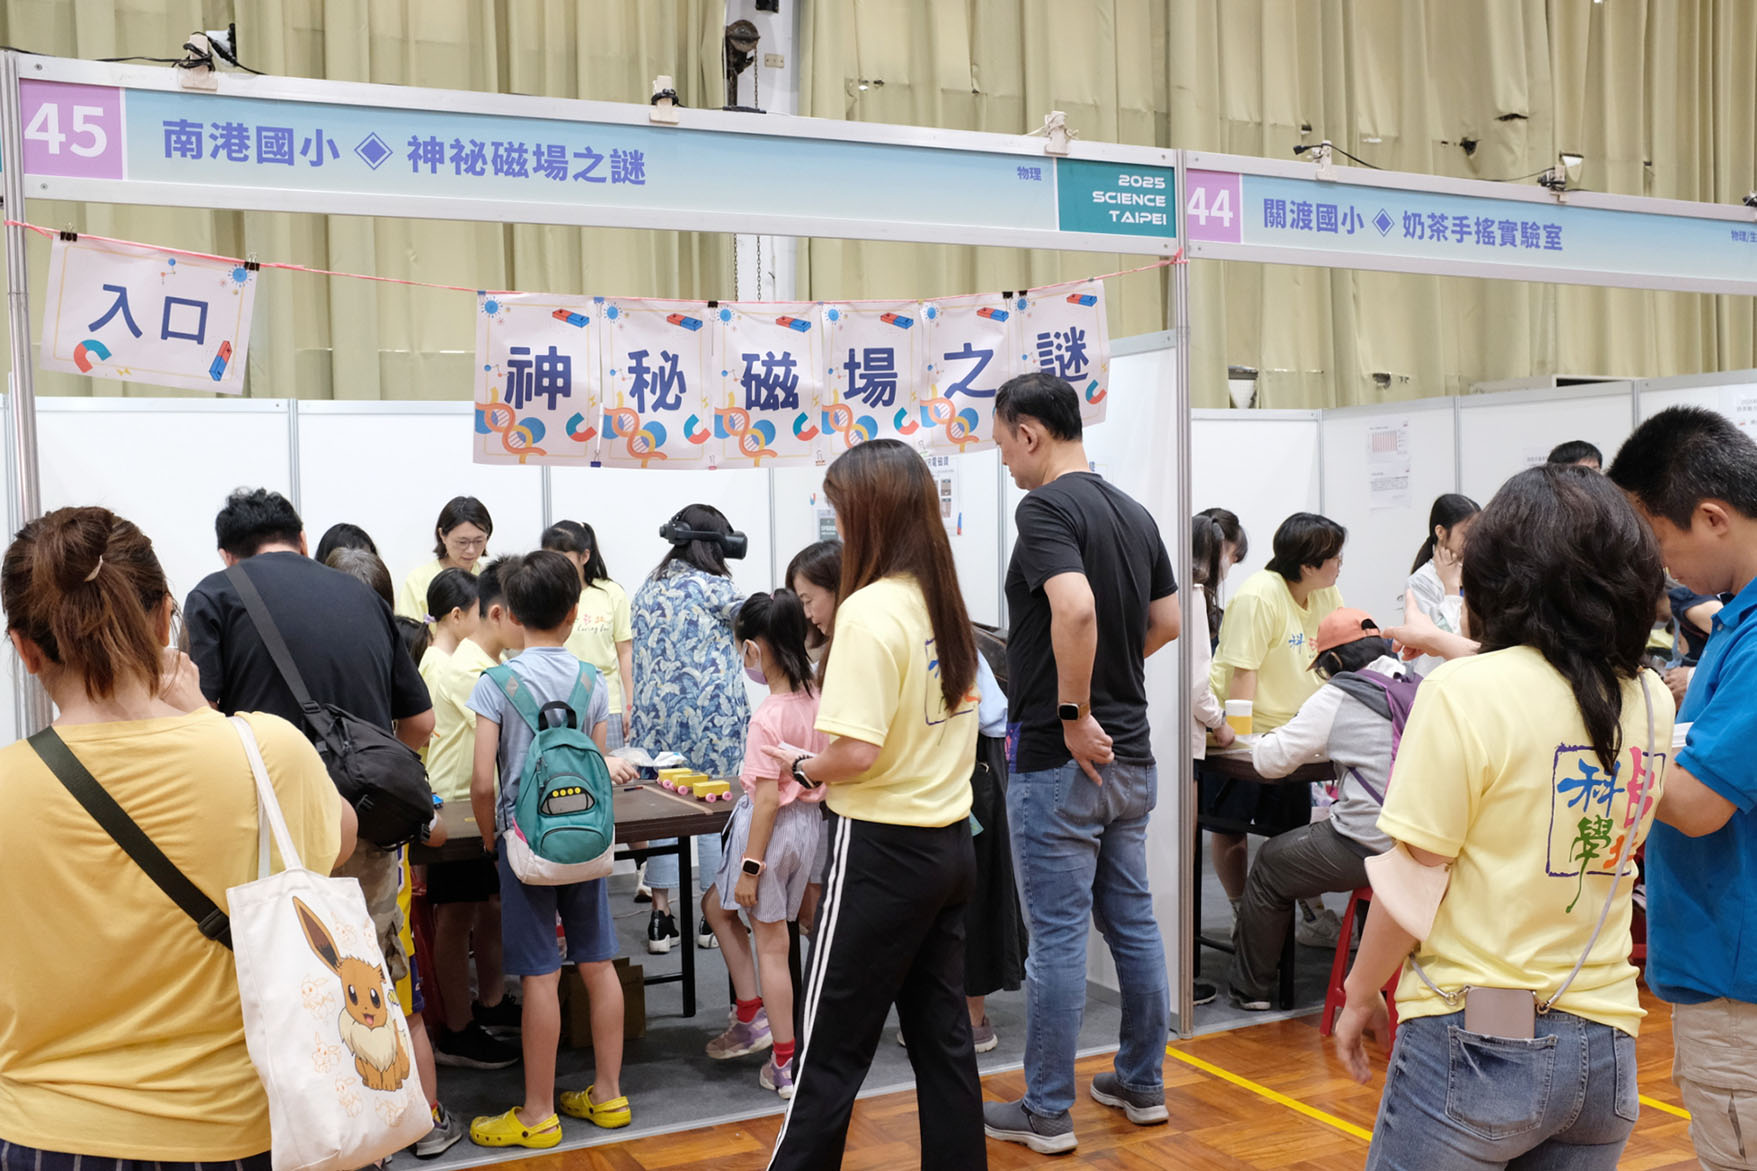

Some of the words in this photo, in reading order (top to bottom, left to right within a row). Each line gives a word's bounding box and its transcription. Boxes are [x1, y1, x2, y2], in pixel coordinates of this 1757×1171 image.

[24, 102, 108, 158] 45
[162, 118, 341, 167] 南港國小
[1016, 166, 1042, 181] 物理
[1118, 174, 1166, 189] 2025
[1092, 191, 1167, 207] SCIENCE
[1108, 210, 1168, 226] TAIPEI
[1187, 185, 1234, 228] 44
[1263, 198, 1365, 235] 關渡國小
[1402, 210, 1564, 251] 奶茶手搖實驗室
[87, 284, 209, 345] 入口
